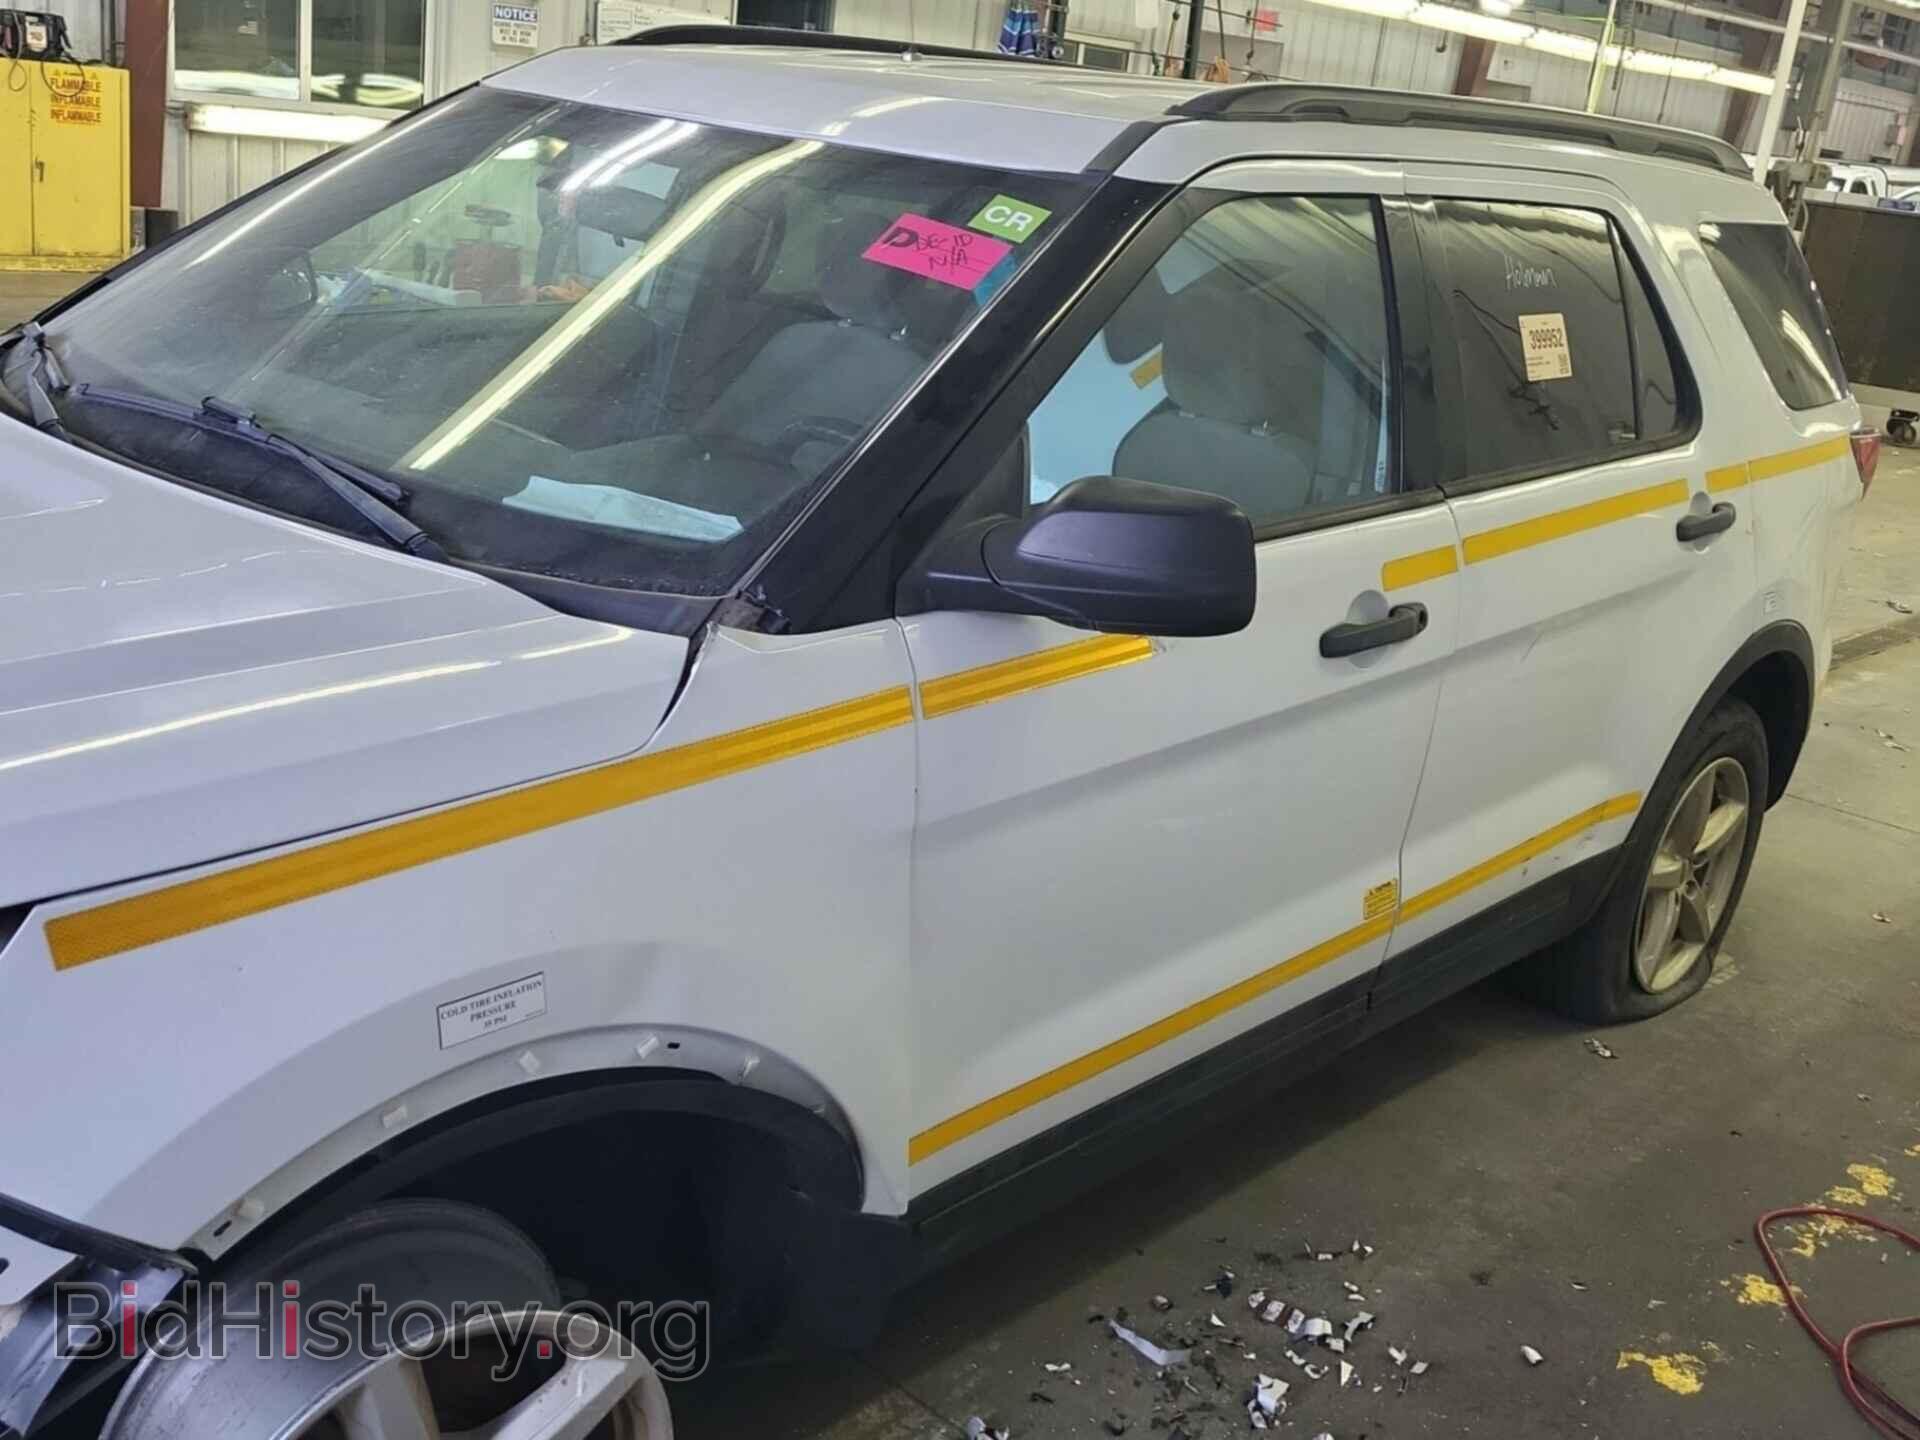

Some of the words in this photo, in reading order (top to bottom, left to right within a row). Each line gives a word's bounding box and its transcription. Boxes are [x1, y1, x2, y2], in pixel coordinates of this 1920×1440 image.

[495, 6, 537, 21] NOTICE
[984, 206, 1033, 232] CR
[1529, 328, 1564, 350] 399952
[441, 1006, 468, 1020] COLD
[470, 997, 491, 1010] TIRE
[494, 980, 543, 1001] INFLATION
[470, 1001, 516, 1022] PRESSURE
[494, 1014, 507, 1025] PSI
